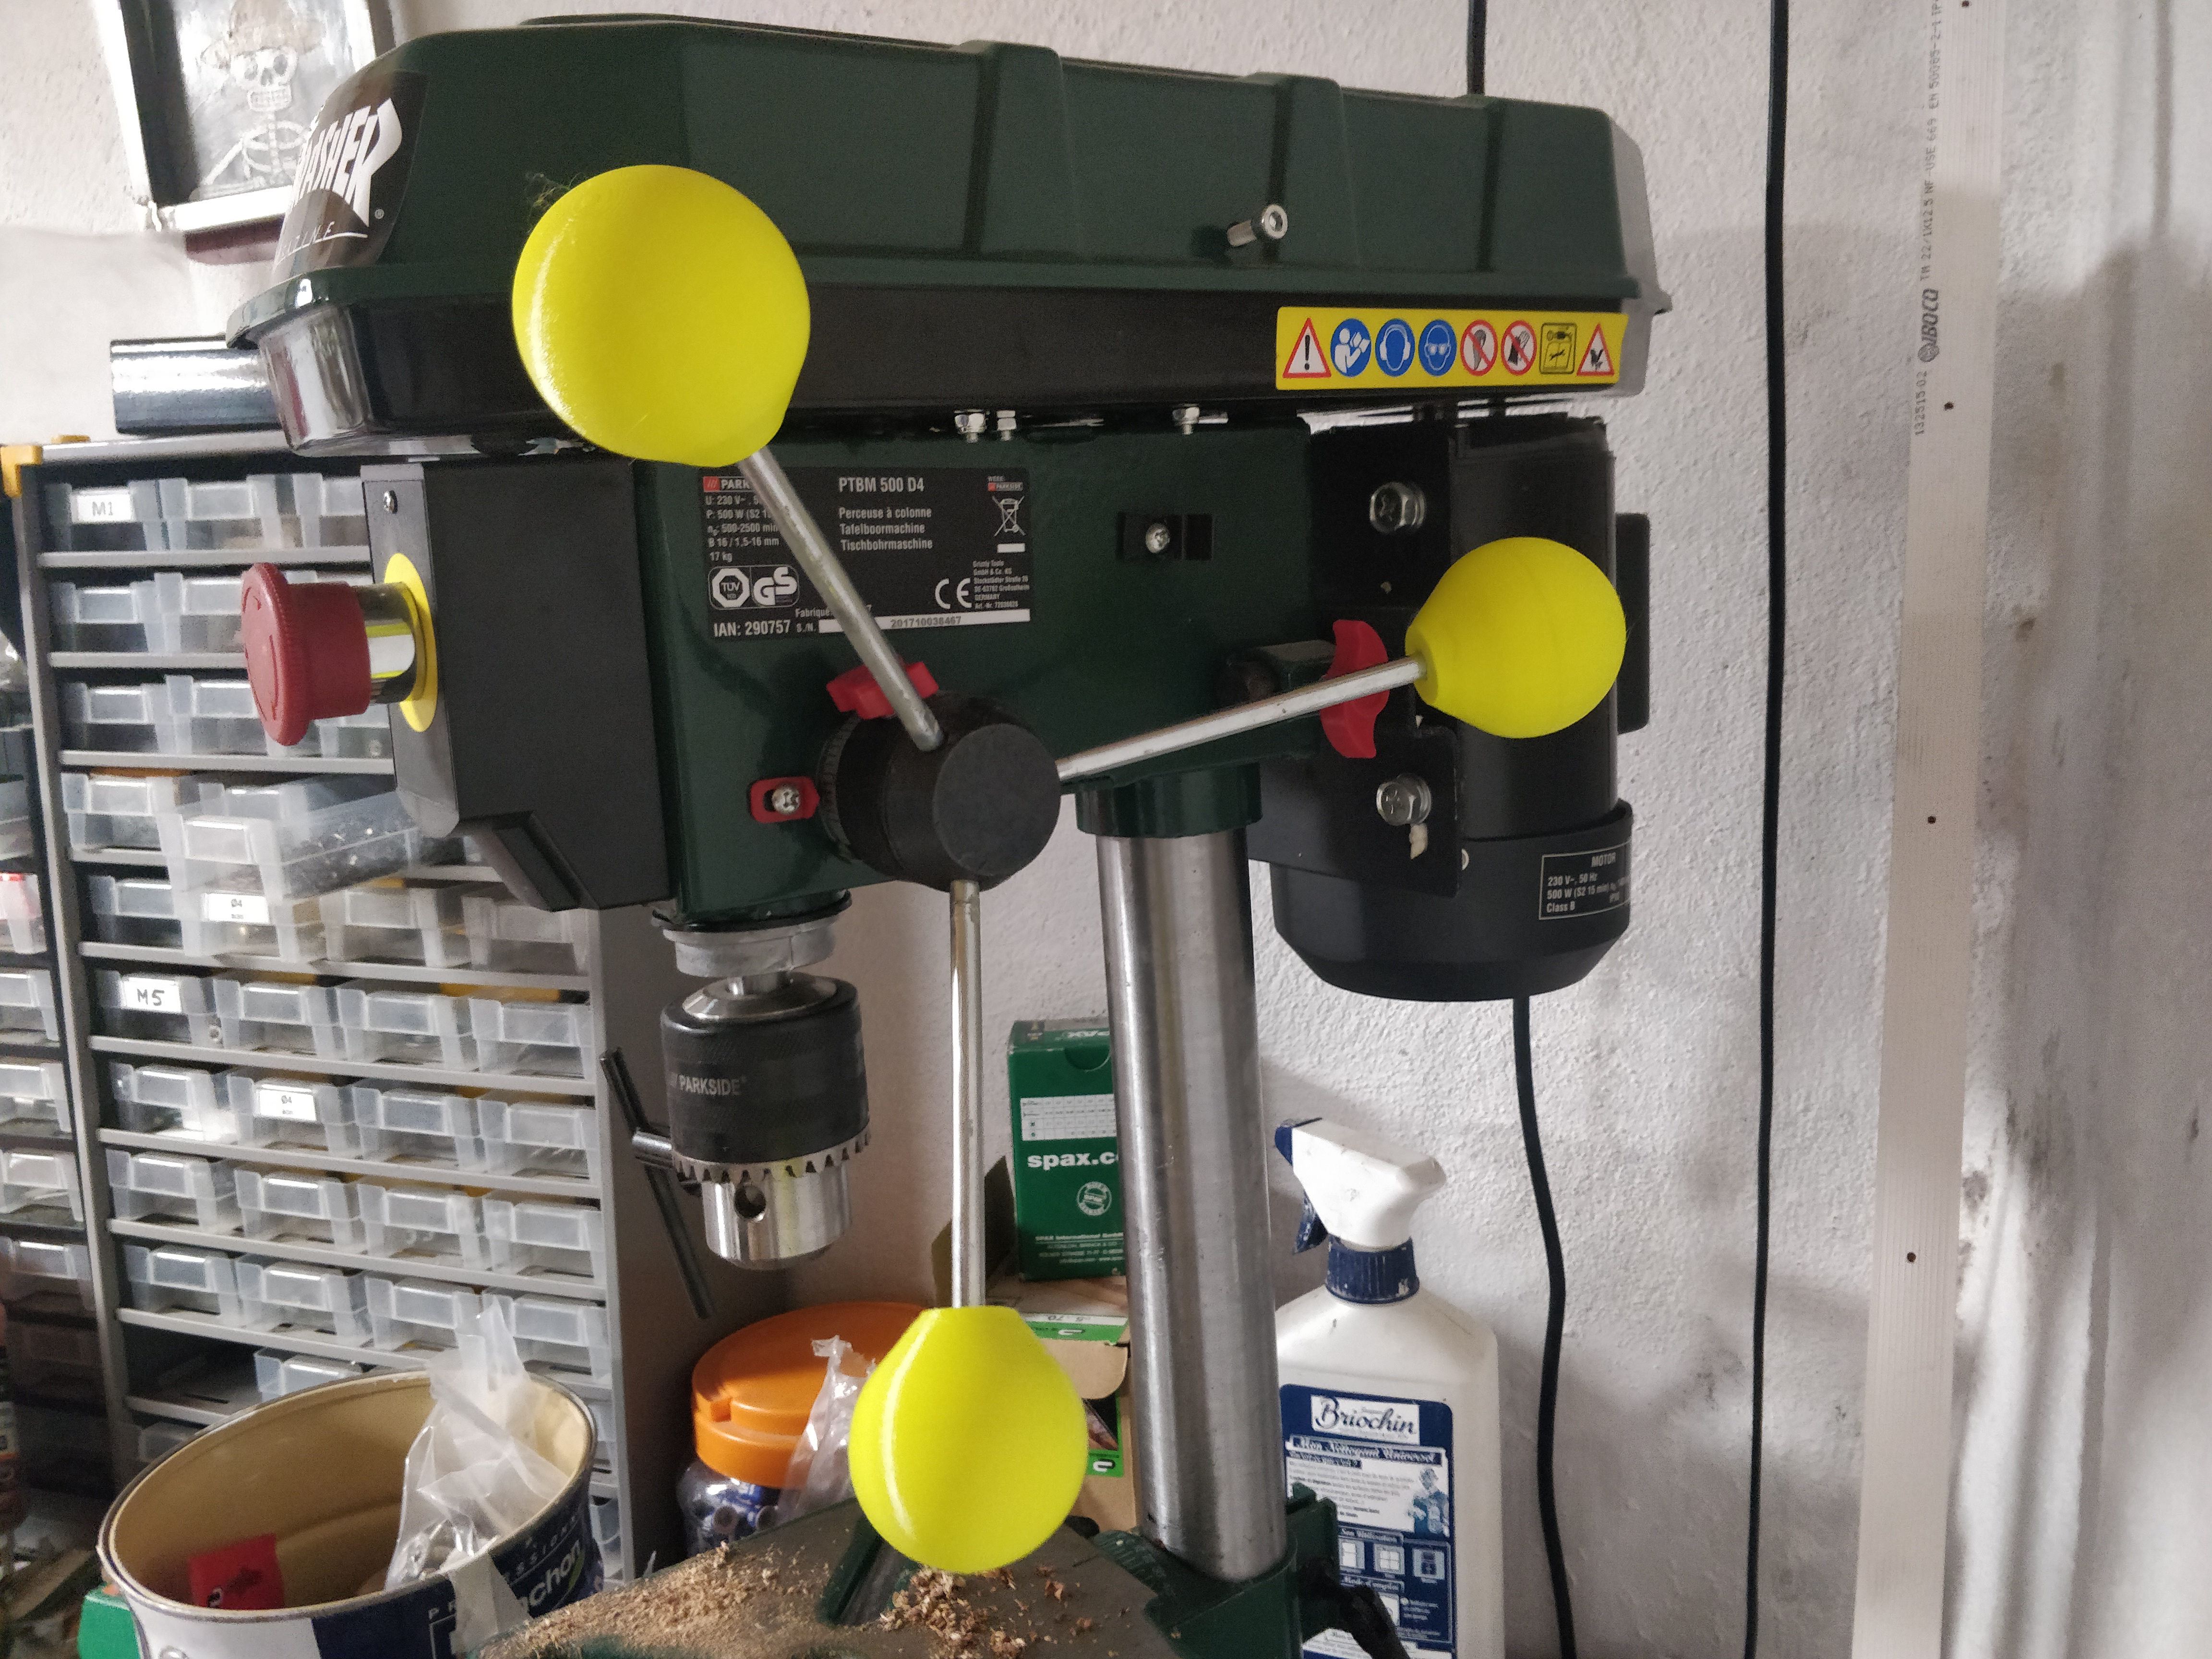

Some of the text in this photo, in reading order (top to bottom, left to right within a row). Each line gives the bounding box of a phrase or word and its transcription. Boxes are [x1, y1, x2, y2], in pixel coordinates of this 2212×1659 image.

[839, 476, 925, 493] PTBM 500 D4
[717, 495, 733, 505] 230
[92, 501, 113, 517] M1
[735, 509, 744, 519] W
[839, 506, 932, 519] Perceuse à colonne
[839, 522, 925, 536] Tafelboormachine
[764, 537, 779, 546] mm
[840, 538, 933, 552] Tischbohrmaschine
[709, 551, 733, 563] 17 kg
[714, 619, 791, 637] IAN: 290757
[1591, 852, 1617, 868] MOTOR
[1548, 876, 1563, 887] 230
[1579, 873, 1588, 883] 50
[1547, 889, 1562, 900] 500
[1564, 888, 1573, 899] W
[1574, 887, 1586, 899] (S2
[1588, 885, 1596, 895] 15
[1547, 902, 1568, 914] Class
[137, 988, 165, 1006] M5
[678, 1074, 742, 1096] PARKSIDE
[1027, 1152, 1119, 1170] spax.c
